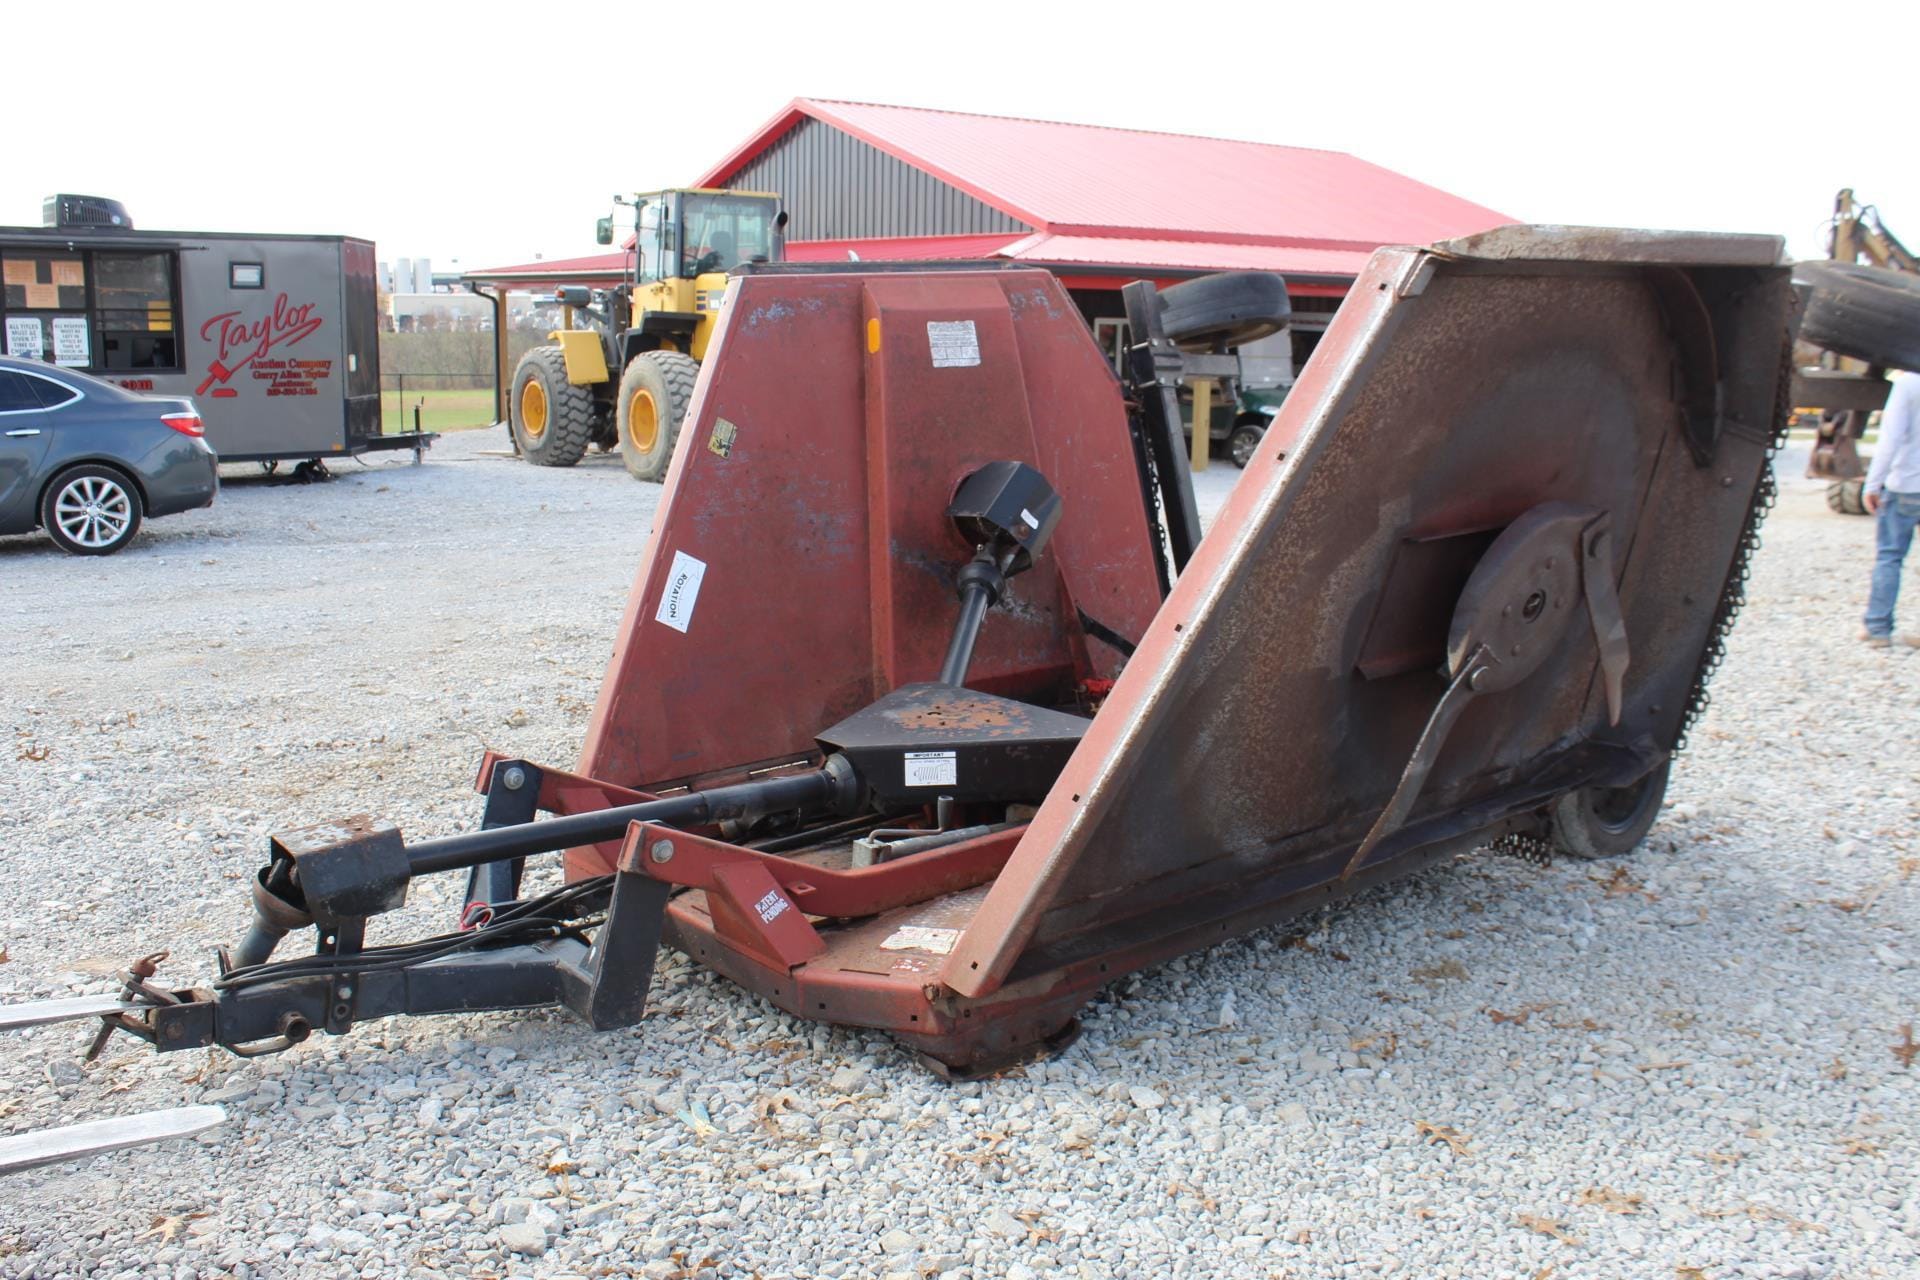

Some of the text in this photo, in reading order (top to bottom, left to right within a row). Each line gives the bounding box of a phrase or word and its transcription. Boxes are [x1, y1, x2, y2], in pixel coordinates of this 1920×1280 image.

[200, 292, 321, 359] Taylor
[249, 358, 332, 370] Auction Company
[280, 370, 302, 379] Allen
[303, 370, 330, 380] Taylor
[670, 573, 688, 618] ROTATION
[754, 890, 779, 915] PATENT
[761, 898, 788, 924] PENDING
